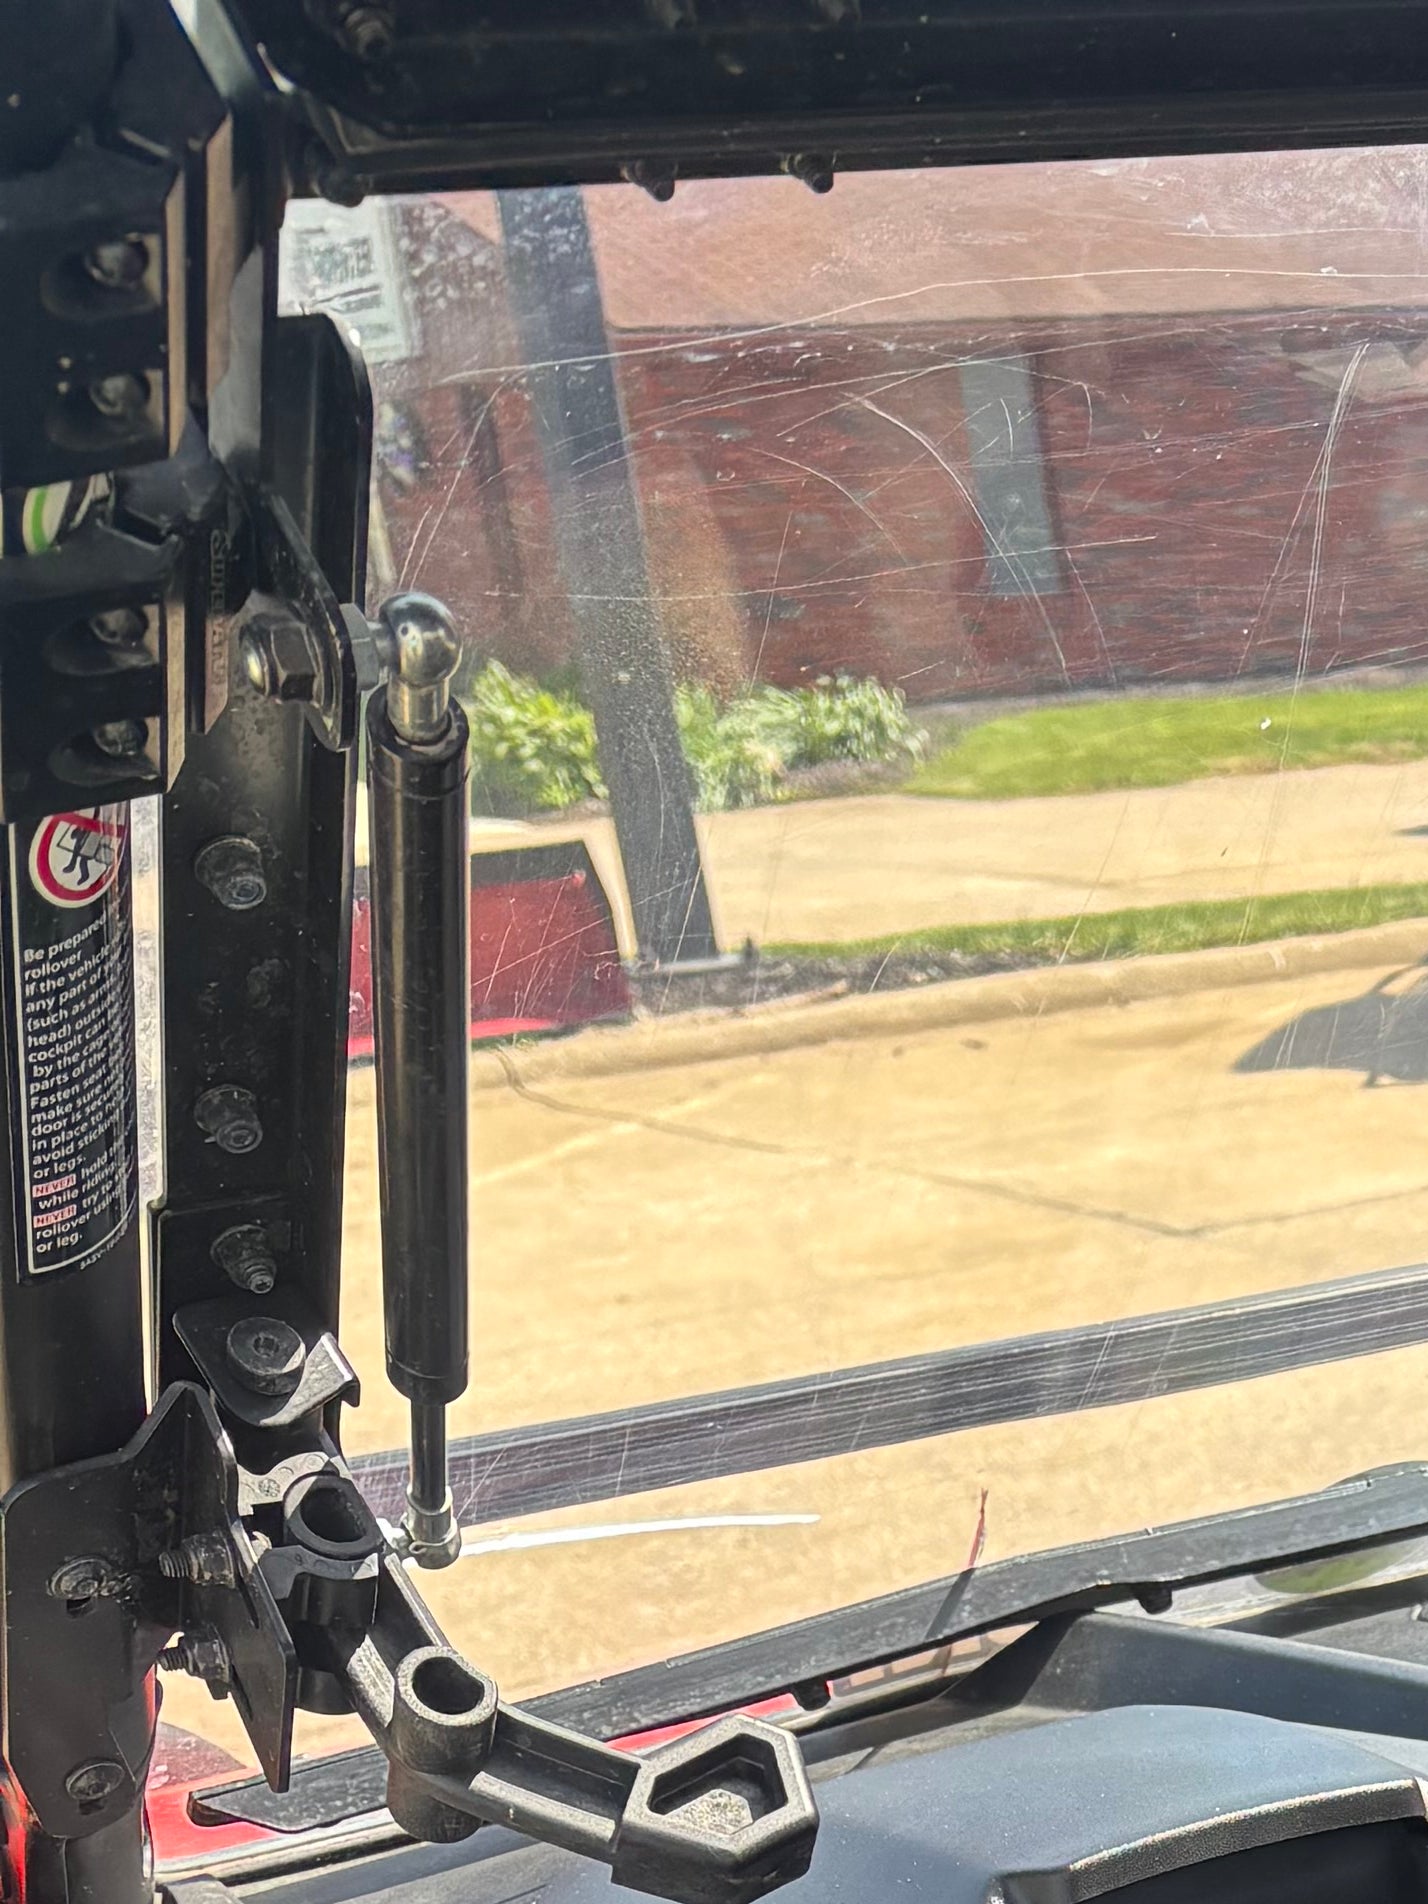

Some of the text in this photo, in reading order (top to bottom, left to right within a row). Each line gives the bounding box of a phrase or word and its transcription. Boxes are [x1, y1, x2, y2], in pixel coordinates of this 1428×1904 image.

[24, 949, 44, 963] Be
[49, 912, 106, 958] prepared
[25, 950, 82, 981] rollover
[26, 997, 55, 1014] any
[59, 983, 86, 1005] part
[40, 977, 65, 994] the
[27, 1008, 68, 1031] (such
[72, 1000, 85, 1015] as
[28, 1024, 71, 1048] head)
[28, 1034, 82, 1063] cockpit
[86, 1018, 105, 1038] can
[30, 1071, 69, 1095] parts
[72, 1061, 86, 1077] of
[33, 1064, 54, 1078] by
[57, 1052, 79, 1070] the
[31, 1083, 79, 1110] Fasten
[31, 1103, 73, 1124] make
[76, 1084, 102, 1108] sure
[31, 1117, 67, 1136] door
[71, 1112, 81, 1124] is
[32, 1138, 47, 1152] in
[52, 1121, 89, 1150] place
[91, 1111, 103, 1127] to
[32, 1144, 74, 1166] avoid
[33, 1155, 86, 1179] or legs.
[35, 1174, 76, 1195] NEVER
[81, 1150, 107, 1180] hold
[38, 1187, 79, 1210] while
[36, 1205, 77, 1226] NEVER
[36, 1211, 91, 1240] rollover
[36, 1230, 83, 1253] or leg.
